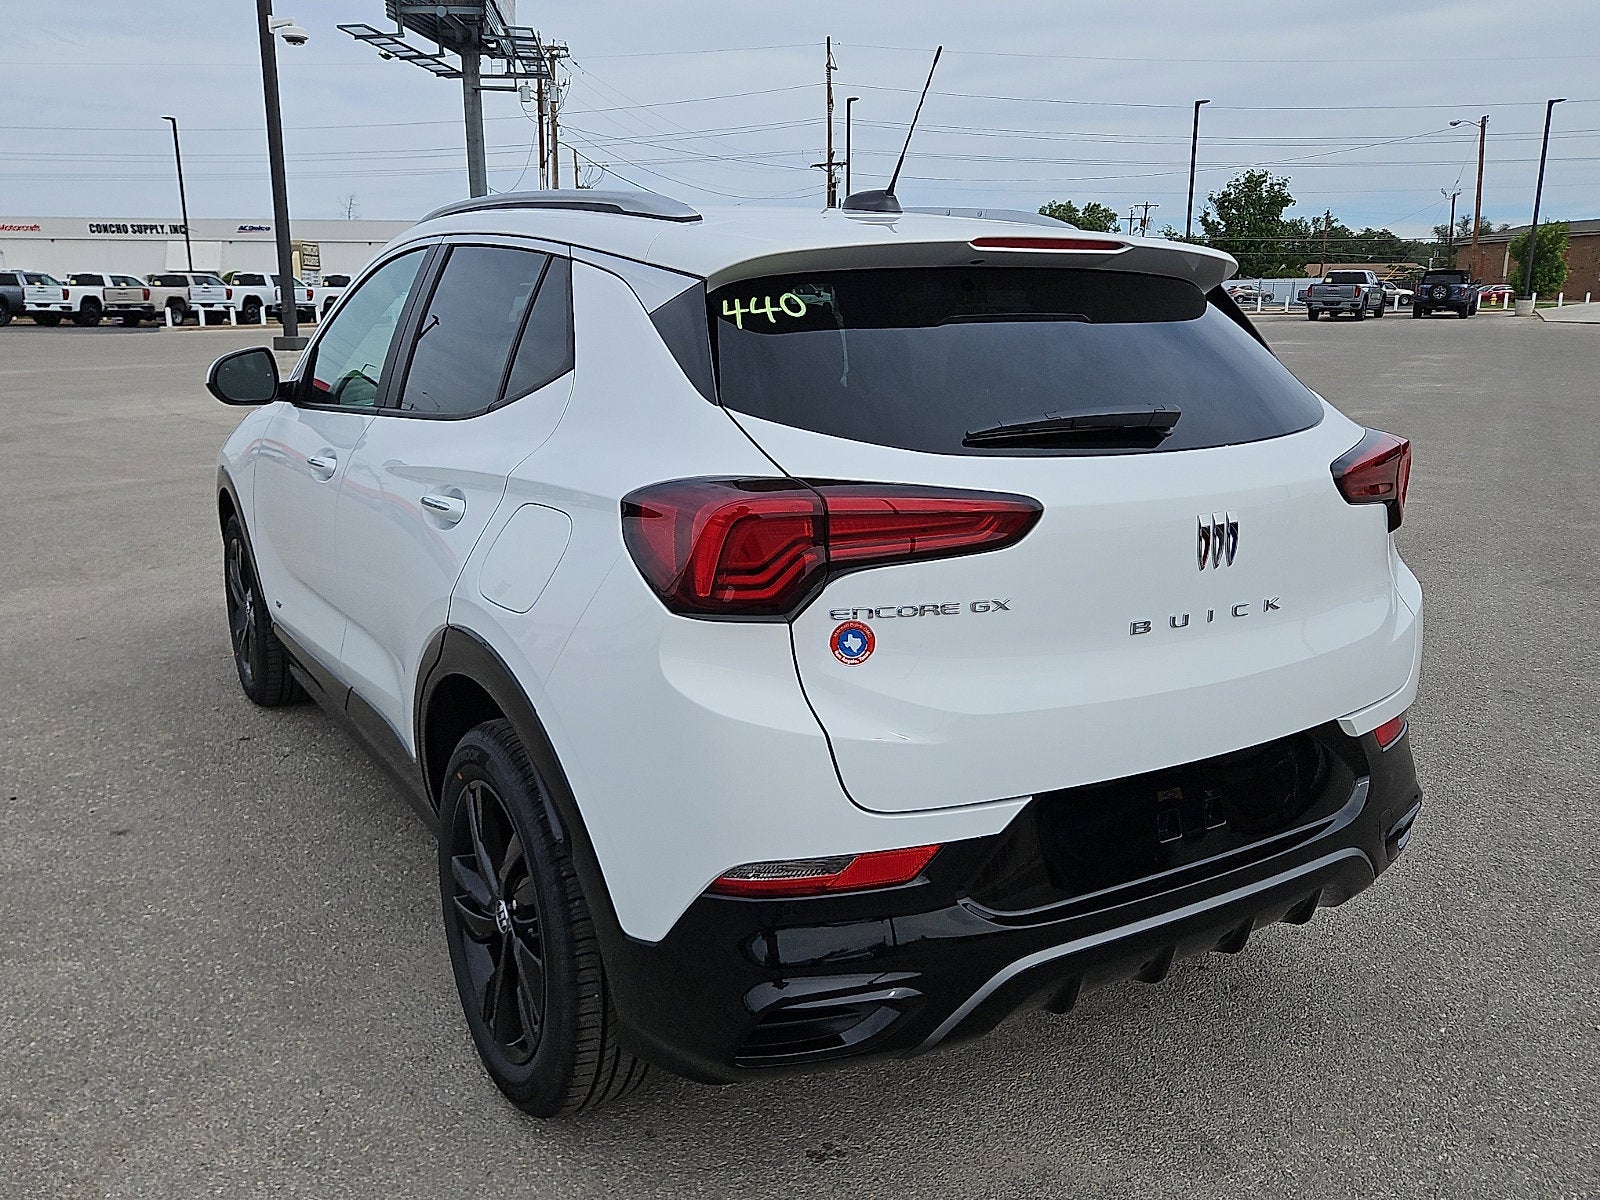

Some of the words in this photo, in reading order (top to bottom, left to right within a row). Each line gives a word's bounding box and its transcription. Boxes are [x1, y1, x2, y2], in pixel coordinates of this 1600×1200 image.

[88, 223, 129, 234] CONCHO
[130, 224, 168, 235] SUPPLY,
[722, 292, 807, 330] 440
[829, 602, 961, 620] ENCORE
[969, 598, 1012, 613] GX
[1129, 597, 1281, 636] BUICK
